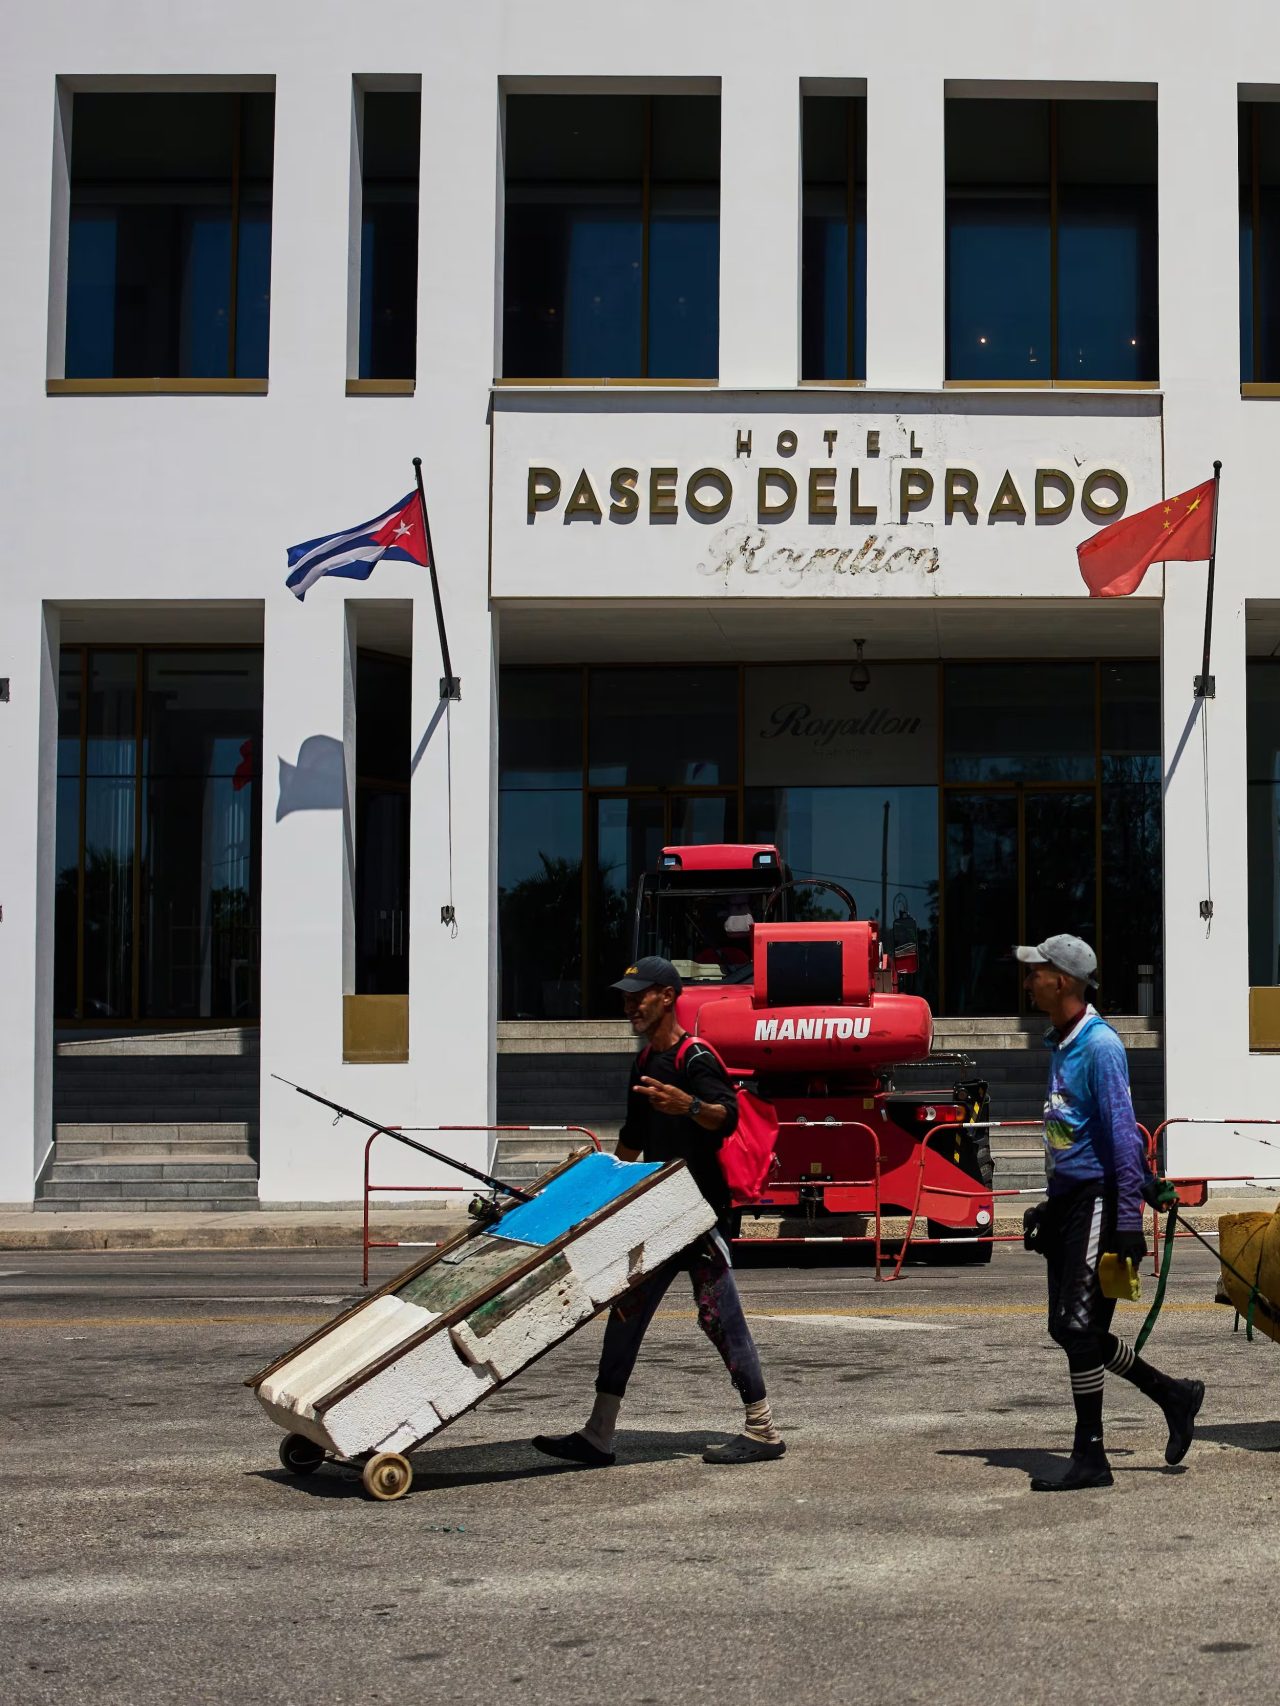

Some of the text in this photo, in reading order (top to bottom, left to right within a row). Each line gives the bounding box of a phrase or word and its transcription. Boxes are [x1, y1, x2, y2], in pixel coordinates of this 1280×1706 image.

[736, 429, 923, 456] HOTEL
[527, 467, 1129, 518] PASEO DEL PRADO
[759, 702, 922, 747] Royalton
[754, 1017, 871, 1040] MANITOU
